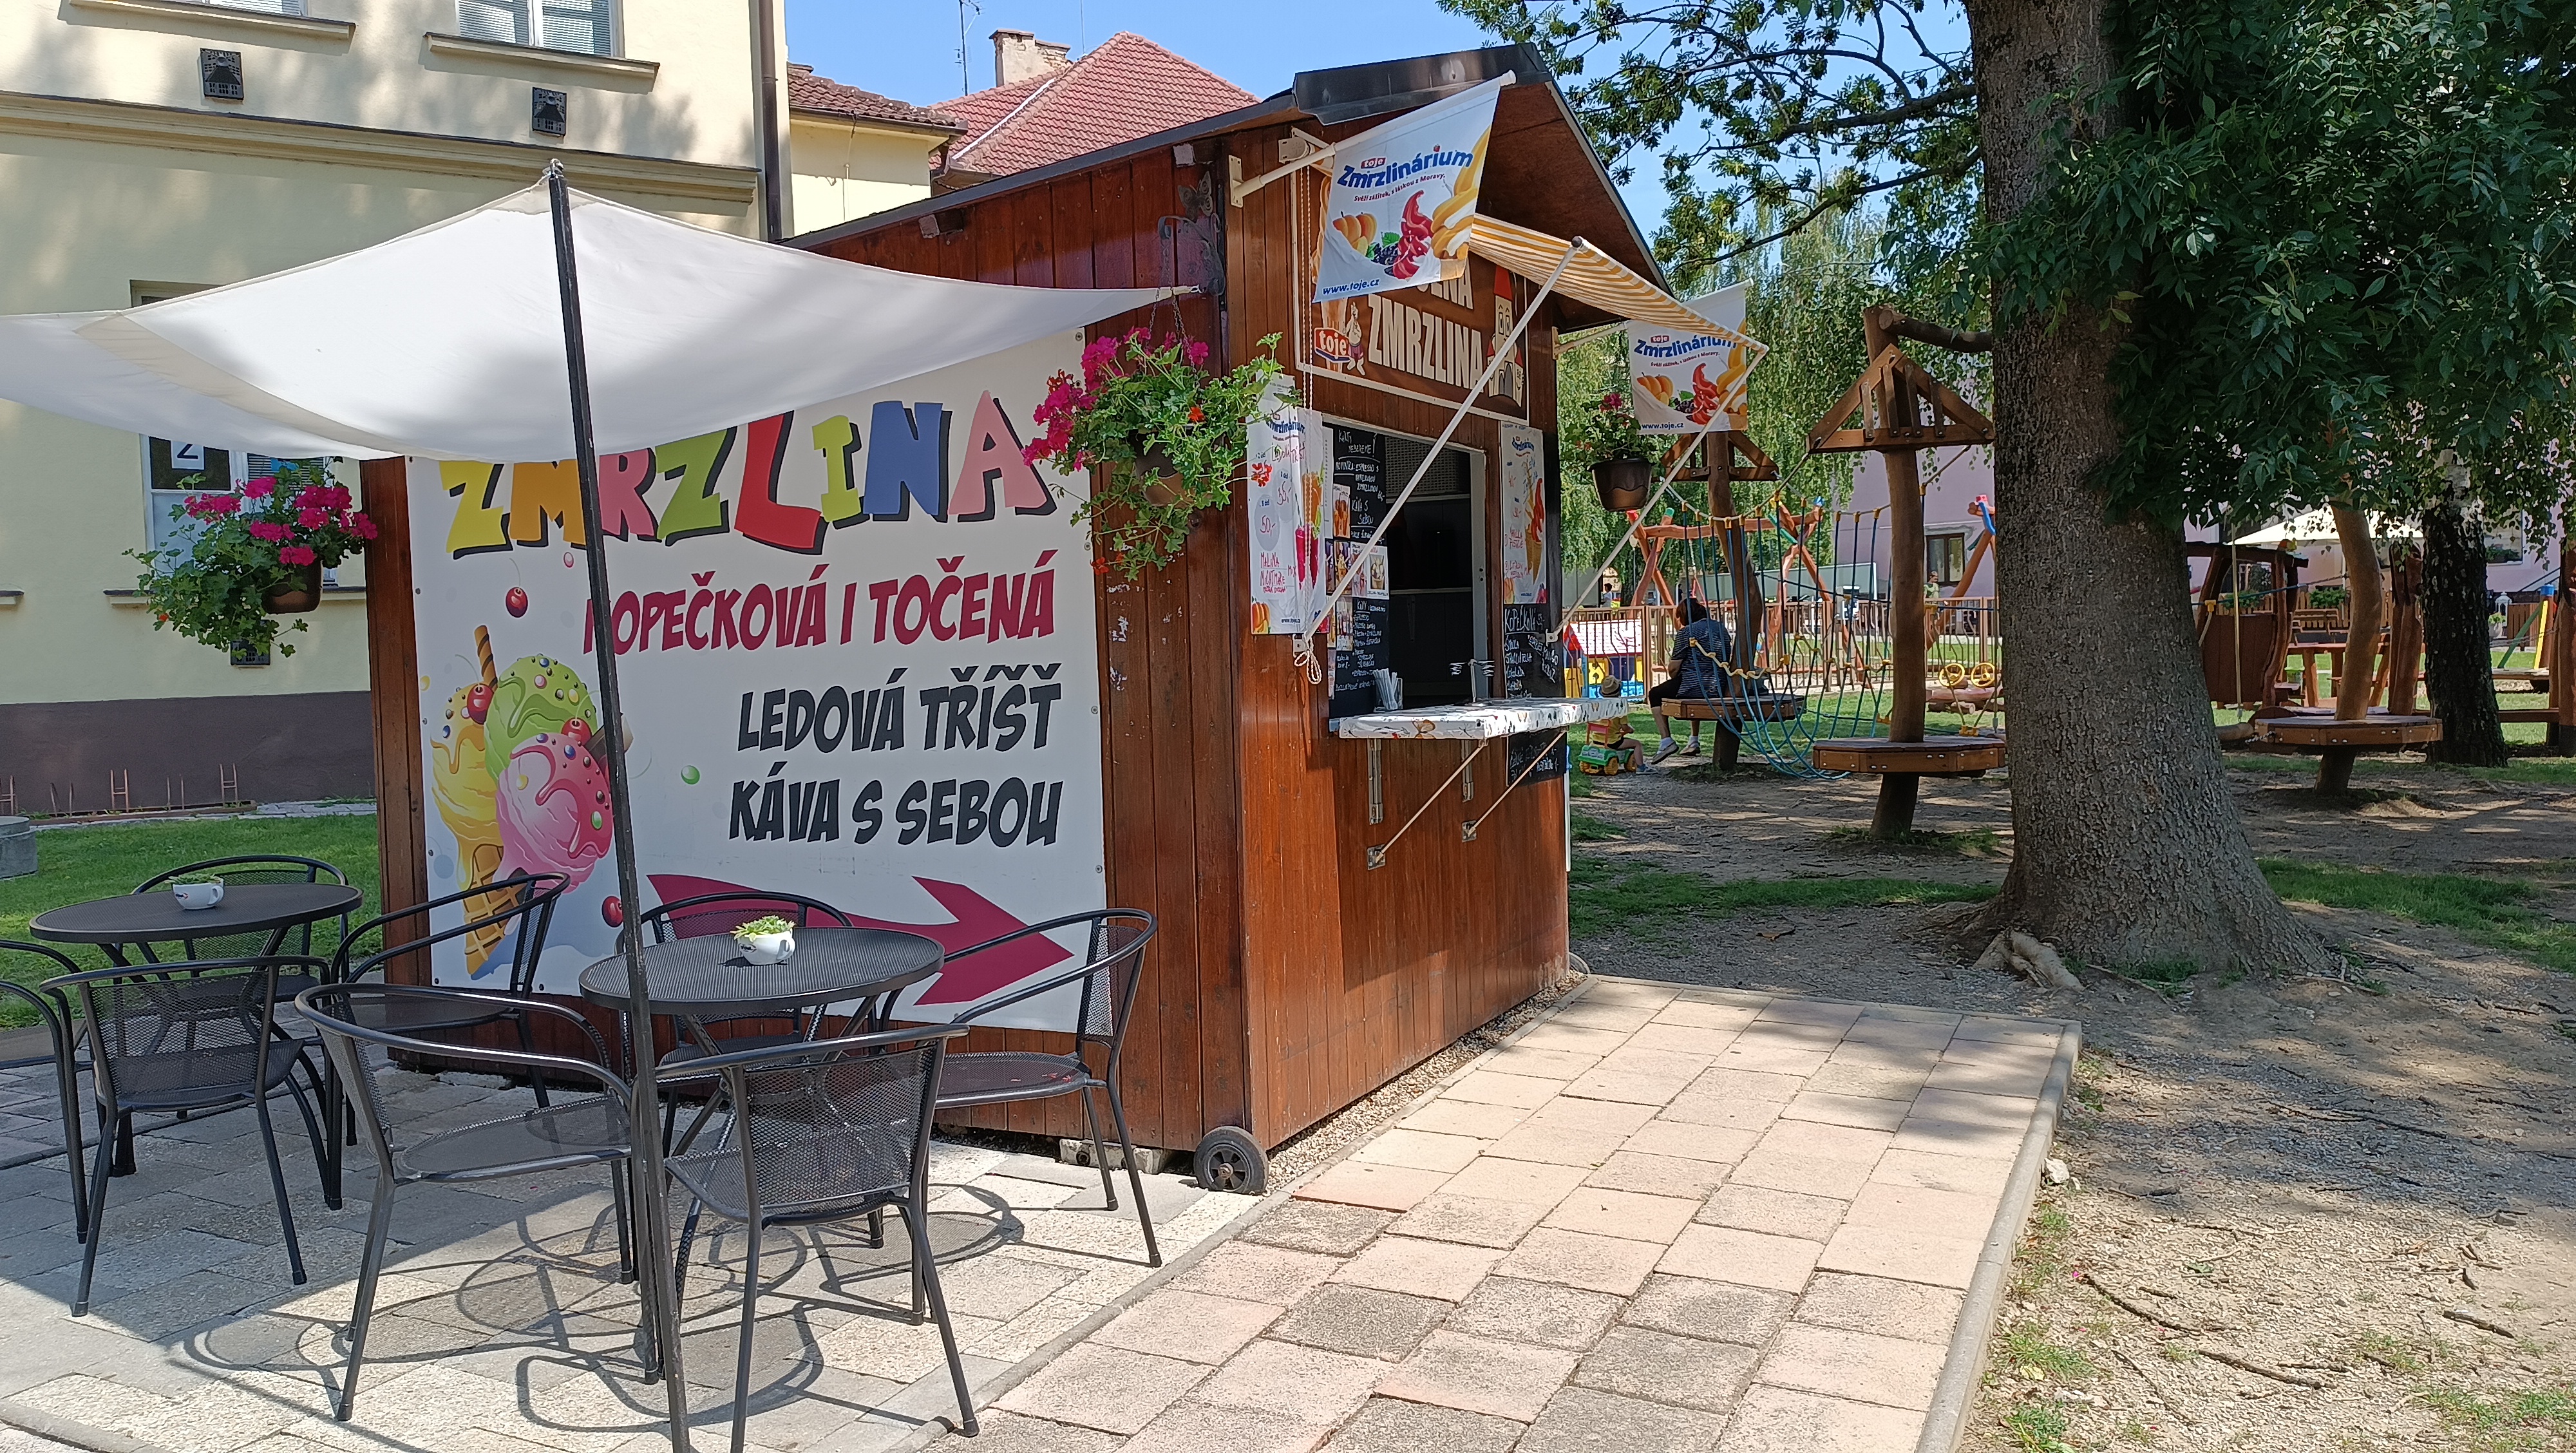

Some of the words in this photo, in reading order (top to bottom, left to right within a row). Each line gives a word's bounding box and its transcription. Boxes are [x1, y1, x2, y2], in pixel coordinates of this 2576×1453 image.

[1337, 144, 1473, 188] Zmrzlinárium
[1364, 158, 1384, 168] toje
[1395, 181, 1414, 193] láskou
[1420, 173, 1446, 182] Moravy.
[1323, 277, 1380, 295] www.toje.cz
[1319, 330, 1347, 359] toje
[1368, 294, 1483, 393] ZMRZLINA
[1642, 422, 1684, 430] www.toje.cz
[439, 390, 1057, 559] ZMRZLINA
[840, 582, 858, 645] I
[868, 549, 1059, 645] TOČENÁ
[737, 667, 909, 754] LEDOVÁ
[919, 662, 1063, 752] TŘÍŠŤ
[728, 761, 840, 843] KÁVA
[851, 779, 884, 845] S
[894, 776, 1064, 848] SEBOU
